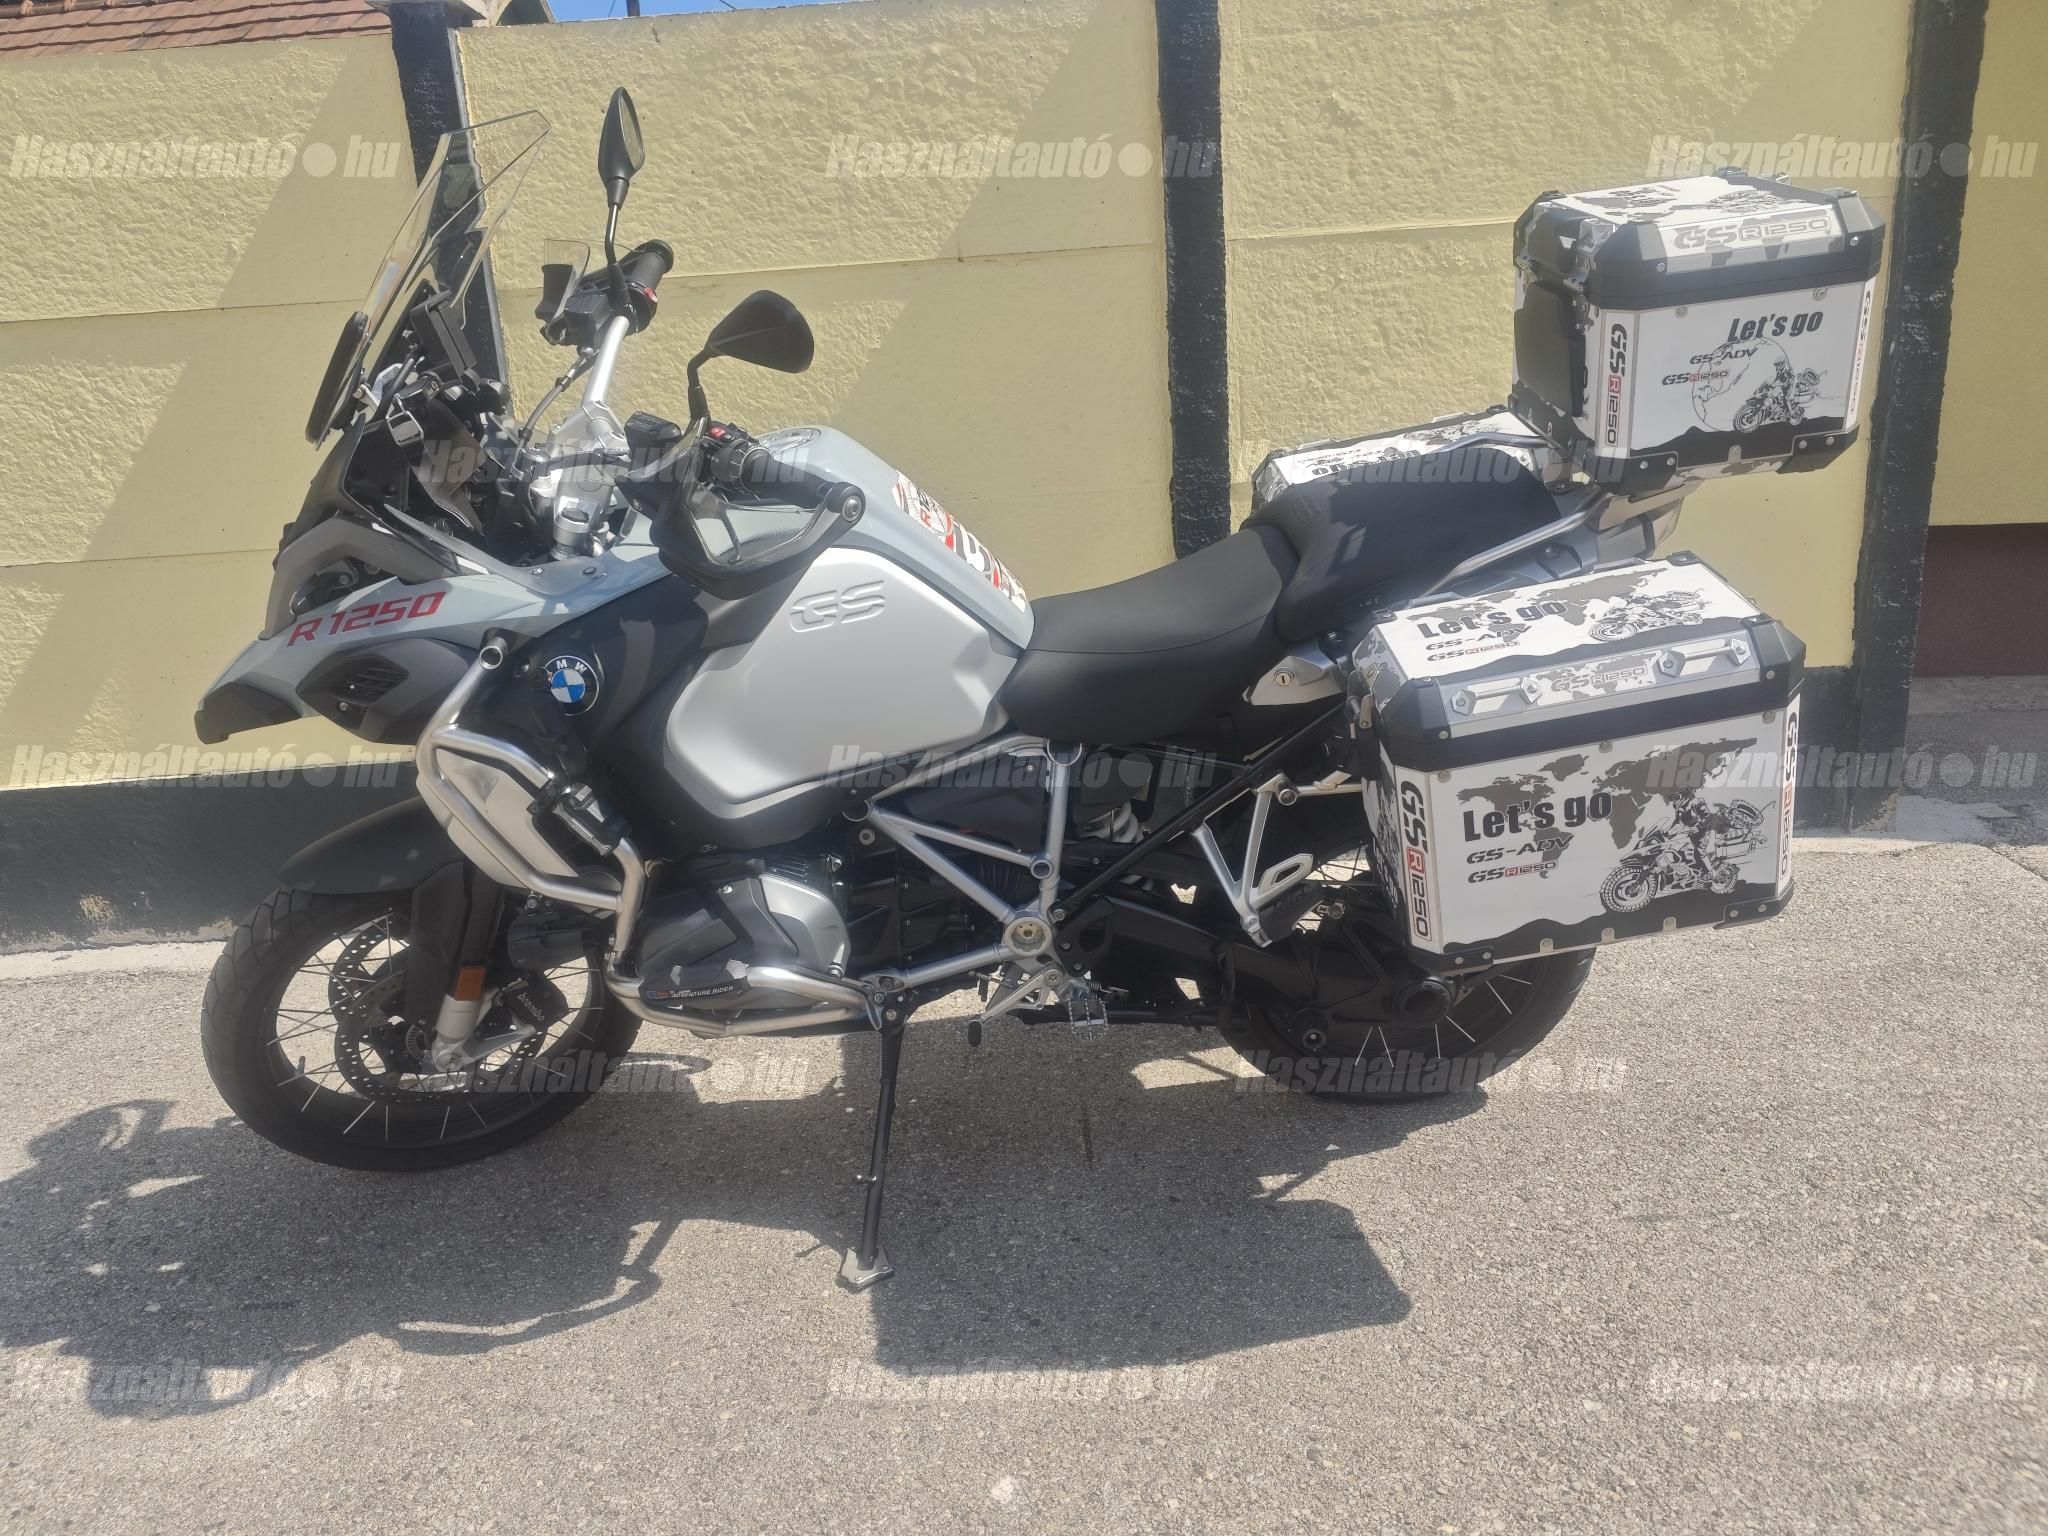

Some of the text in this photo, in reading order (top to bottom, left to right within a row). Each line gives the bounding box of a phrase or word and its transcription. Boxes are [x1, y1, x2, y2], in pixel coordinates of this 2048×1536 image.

[1727, 311, 1824, 342] Let's go
[286, 591, 446, 648] R 1250
[787, 580, 885, 632] GS
[1417, 601, 1568, 638] Let's go
[1463, 792, 1612, 842] Let's go
[517, 991, 545, 1021] brembo
